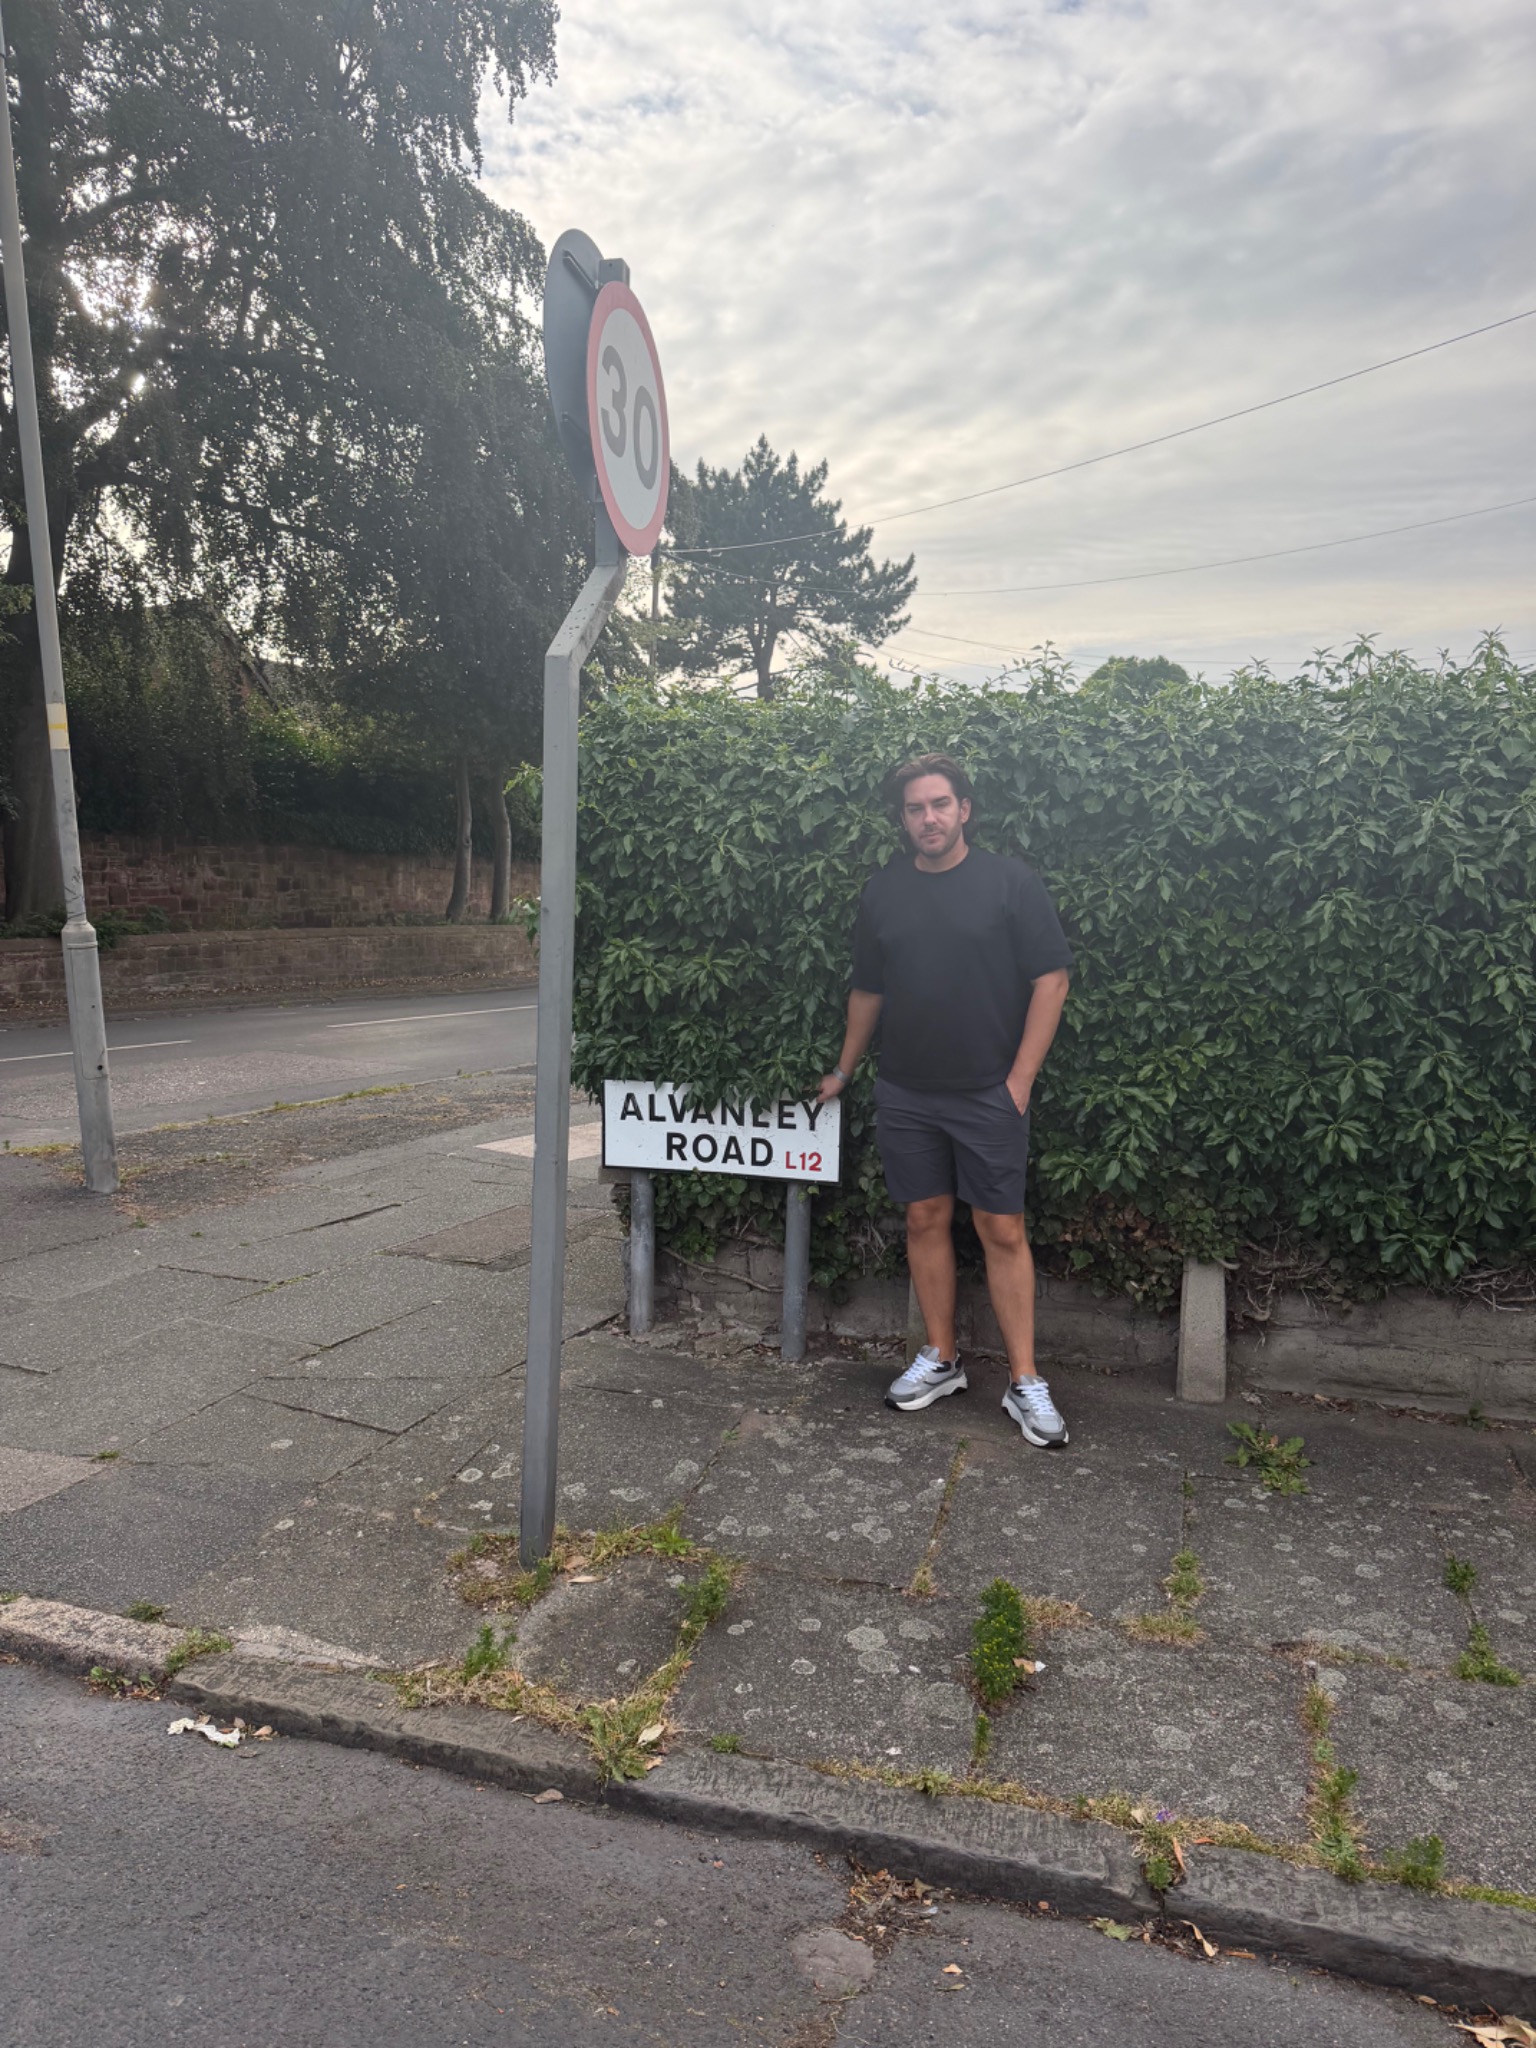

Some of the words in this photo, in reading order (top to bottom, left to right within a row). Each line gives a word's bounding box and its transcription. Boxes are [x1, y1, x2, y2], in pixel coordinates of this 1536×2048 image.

[601, 345, 659, 490] 30
[620, 1092, 825, 1131] ALVANLEY
[666, 1132, 774, 1167] ROAD
[785, 1151, 823, 1172] L12
